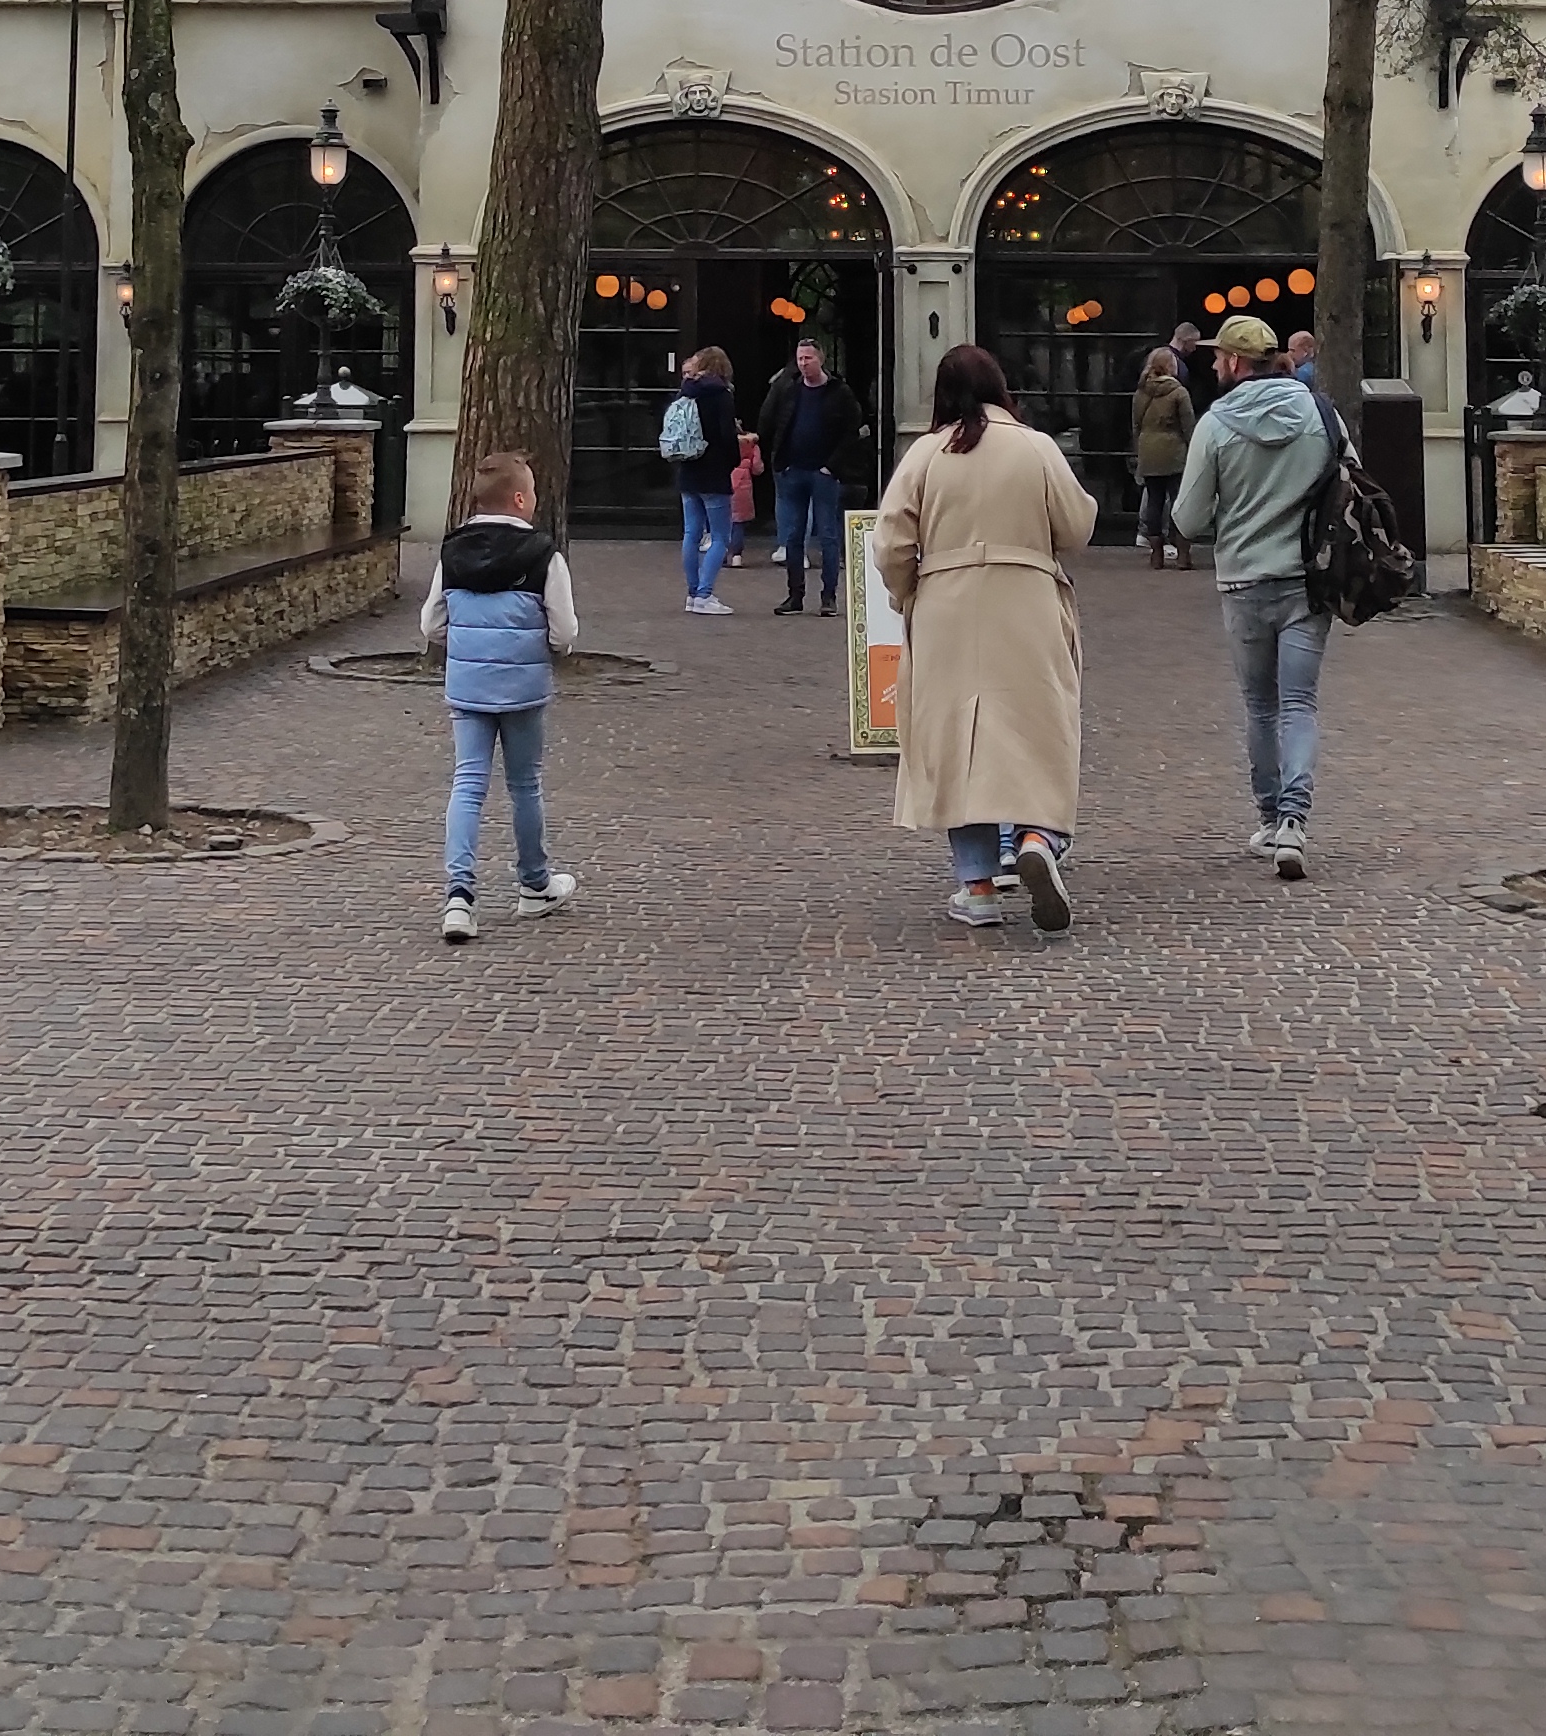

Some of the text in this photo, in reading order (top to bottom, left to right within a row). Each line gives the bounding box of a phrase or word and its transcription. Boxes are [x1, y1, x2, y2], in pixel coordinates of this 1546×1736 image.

[774, 32, 1088, 68] Station de Oost
[833, 79, 1036, 106] Stasion Timur
